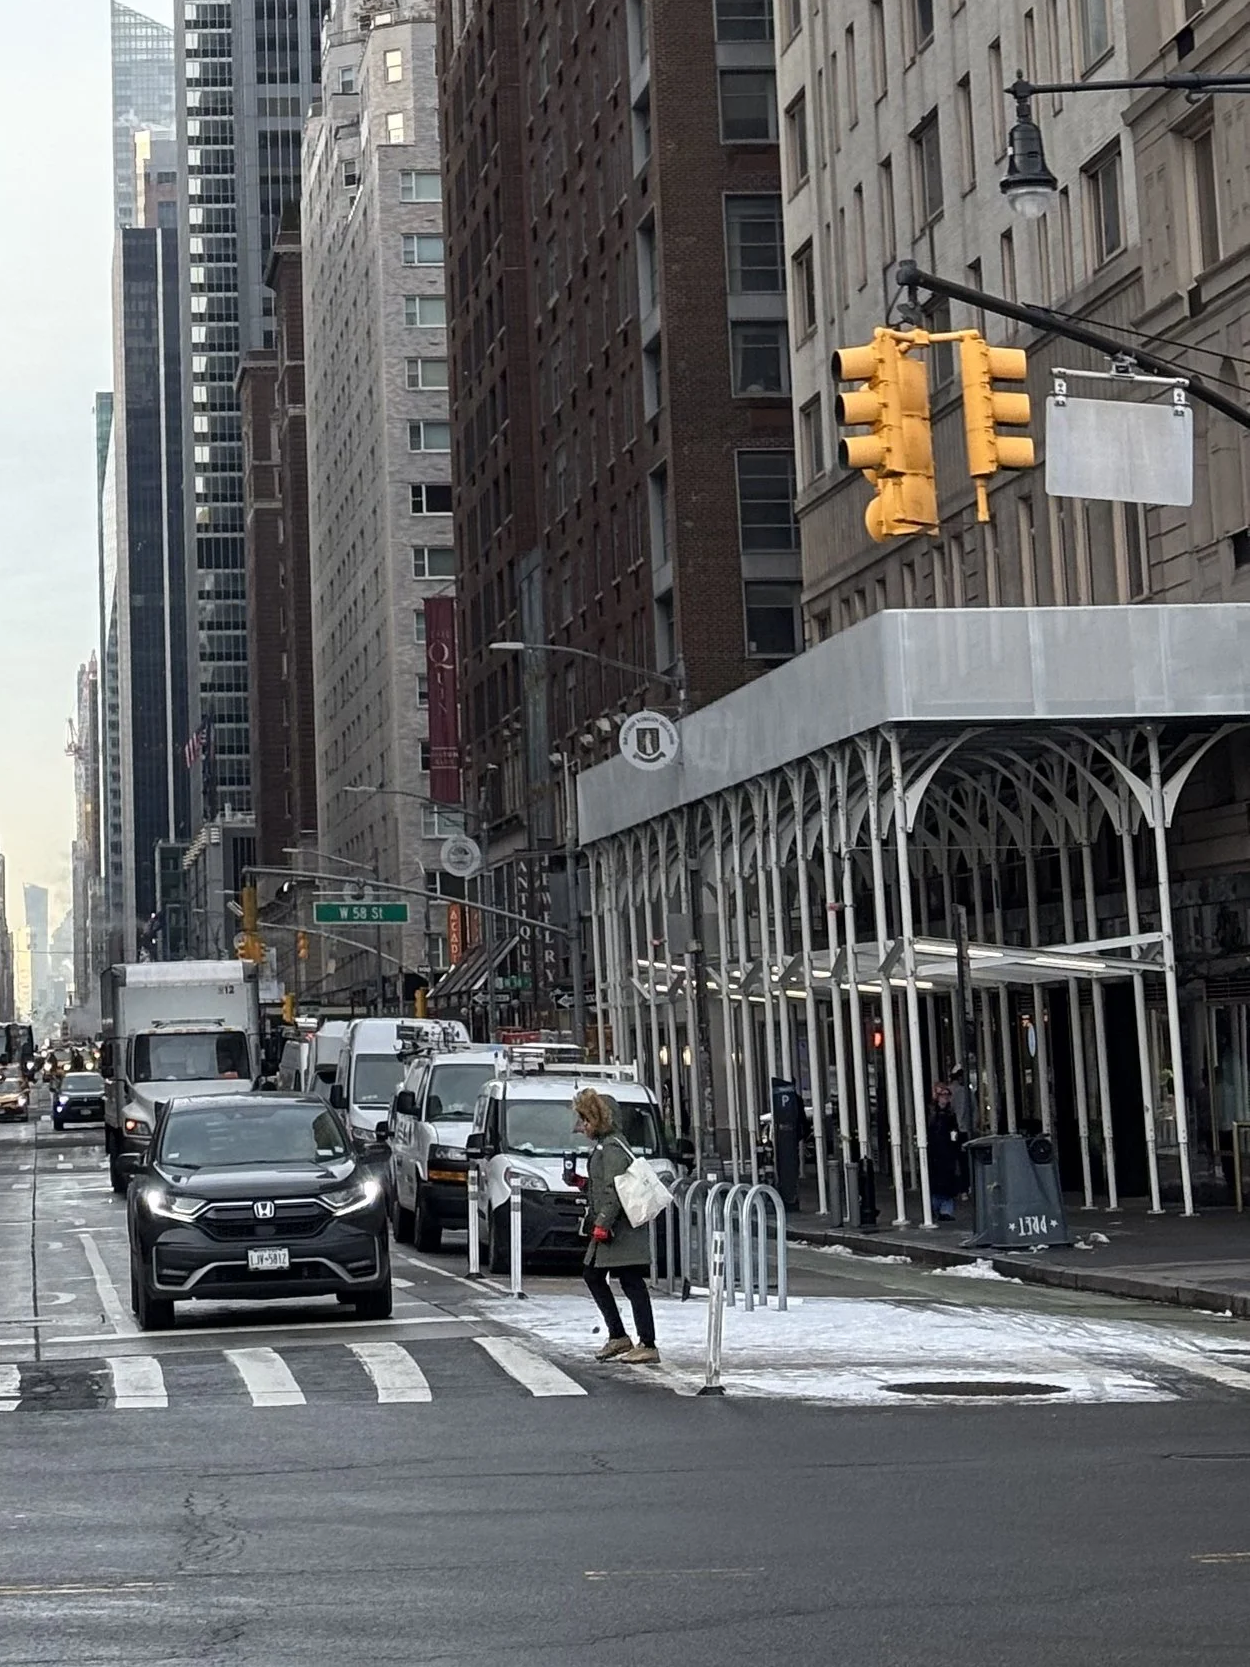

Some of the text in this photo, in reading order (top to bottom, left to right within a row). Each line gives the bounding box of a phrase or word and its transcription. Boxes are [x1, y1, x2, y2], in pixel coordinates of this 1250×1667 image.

[339, 907, 383, 920] W 58 St
[517, 861, 532, 973] ANTIQUE
[541, 854, 556, 983] JEWELRY
[782, 1095, 790, 1107] P
